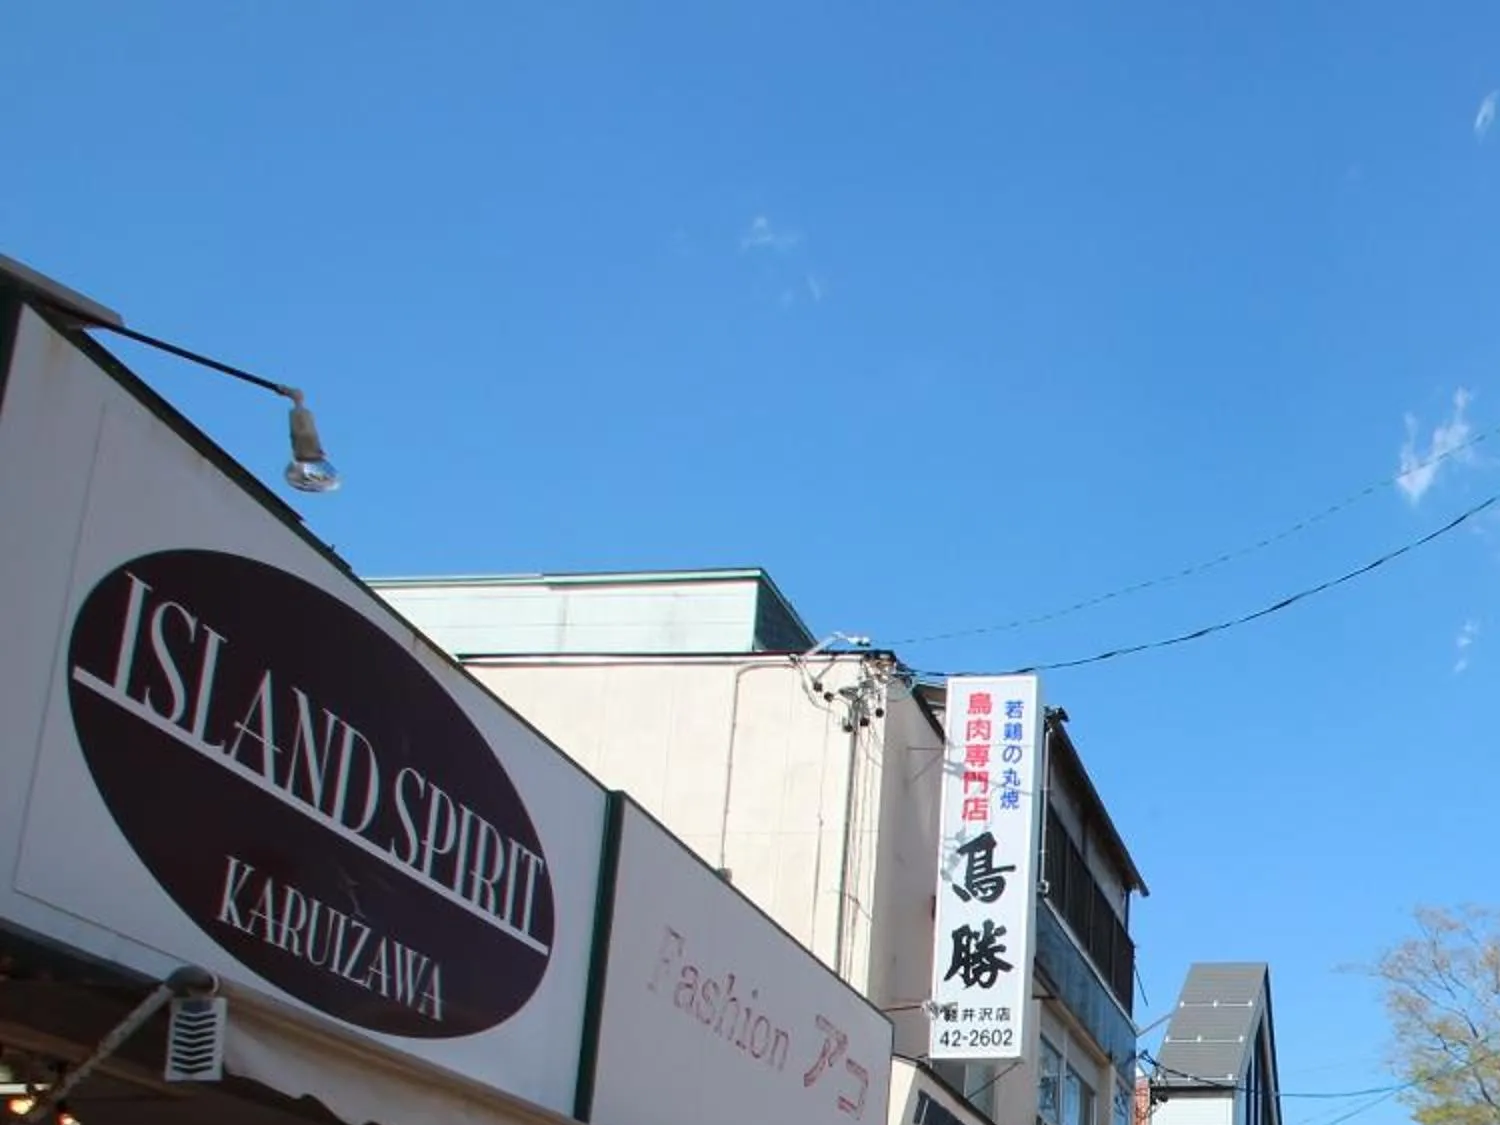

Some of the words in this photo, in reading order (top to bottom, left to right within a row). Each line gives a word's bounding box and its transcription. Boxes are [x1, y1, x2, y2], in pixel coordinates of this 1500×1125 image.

[108, 571, 379, 833] ISLAND
[386, 767, 543, 937] SPIRIT
[962, 692, 992, 821] 鳥肉専門店
[218, 855, 443, 1020] KARUIZAWA
[648, 926, 790, 1072] Fashion
[940, 1029, 1013, 1047] 42-2602
